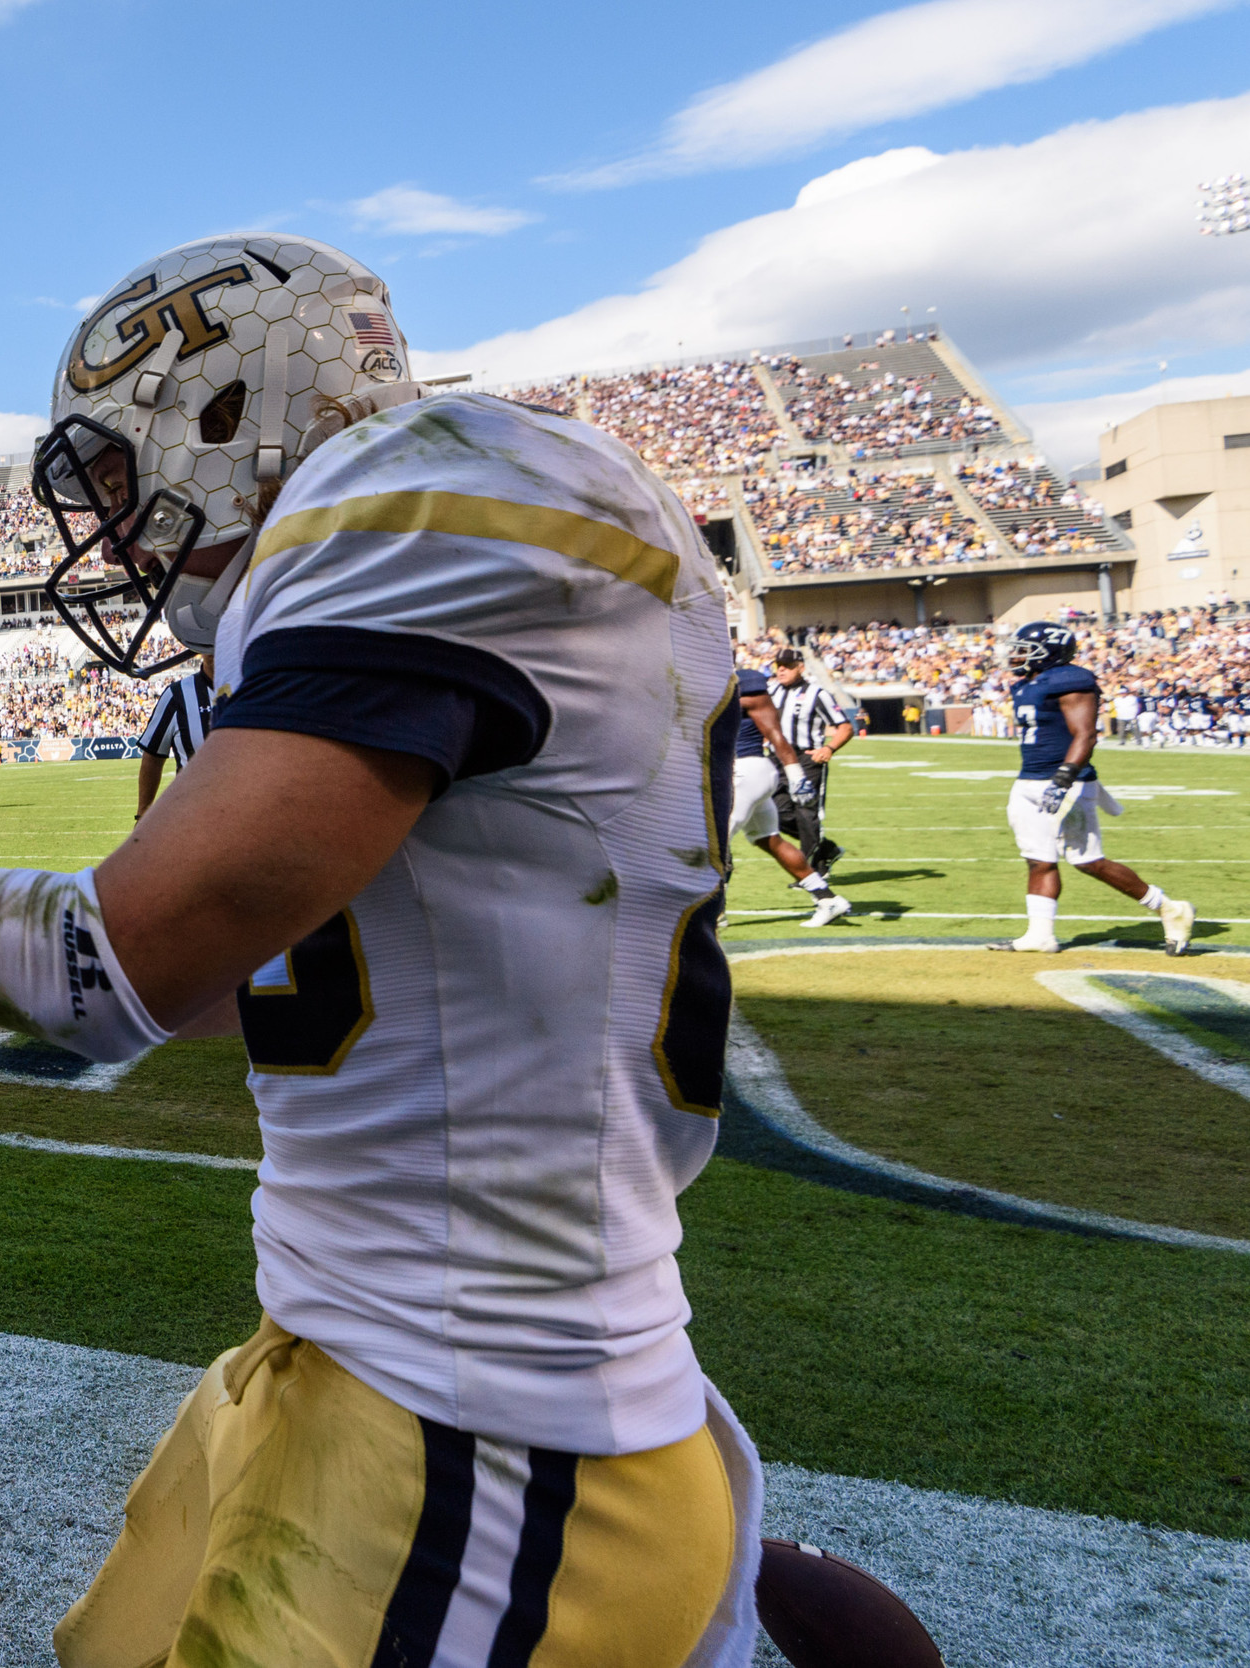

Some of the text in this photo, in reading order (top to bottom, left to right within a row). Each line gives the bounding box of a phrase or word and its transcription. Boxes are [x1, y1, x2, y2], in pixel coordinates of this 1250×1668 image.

[67, 263, 254, 394] GT
[370, 357, 396, 371] ACC
[1043, 627, 1072, 645] 27
[101, 742, 124, 751] DELTA
[63, 909, 87, 1021] RUSSELL
